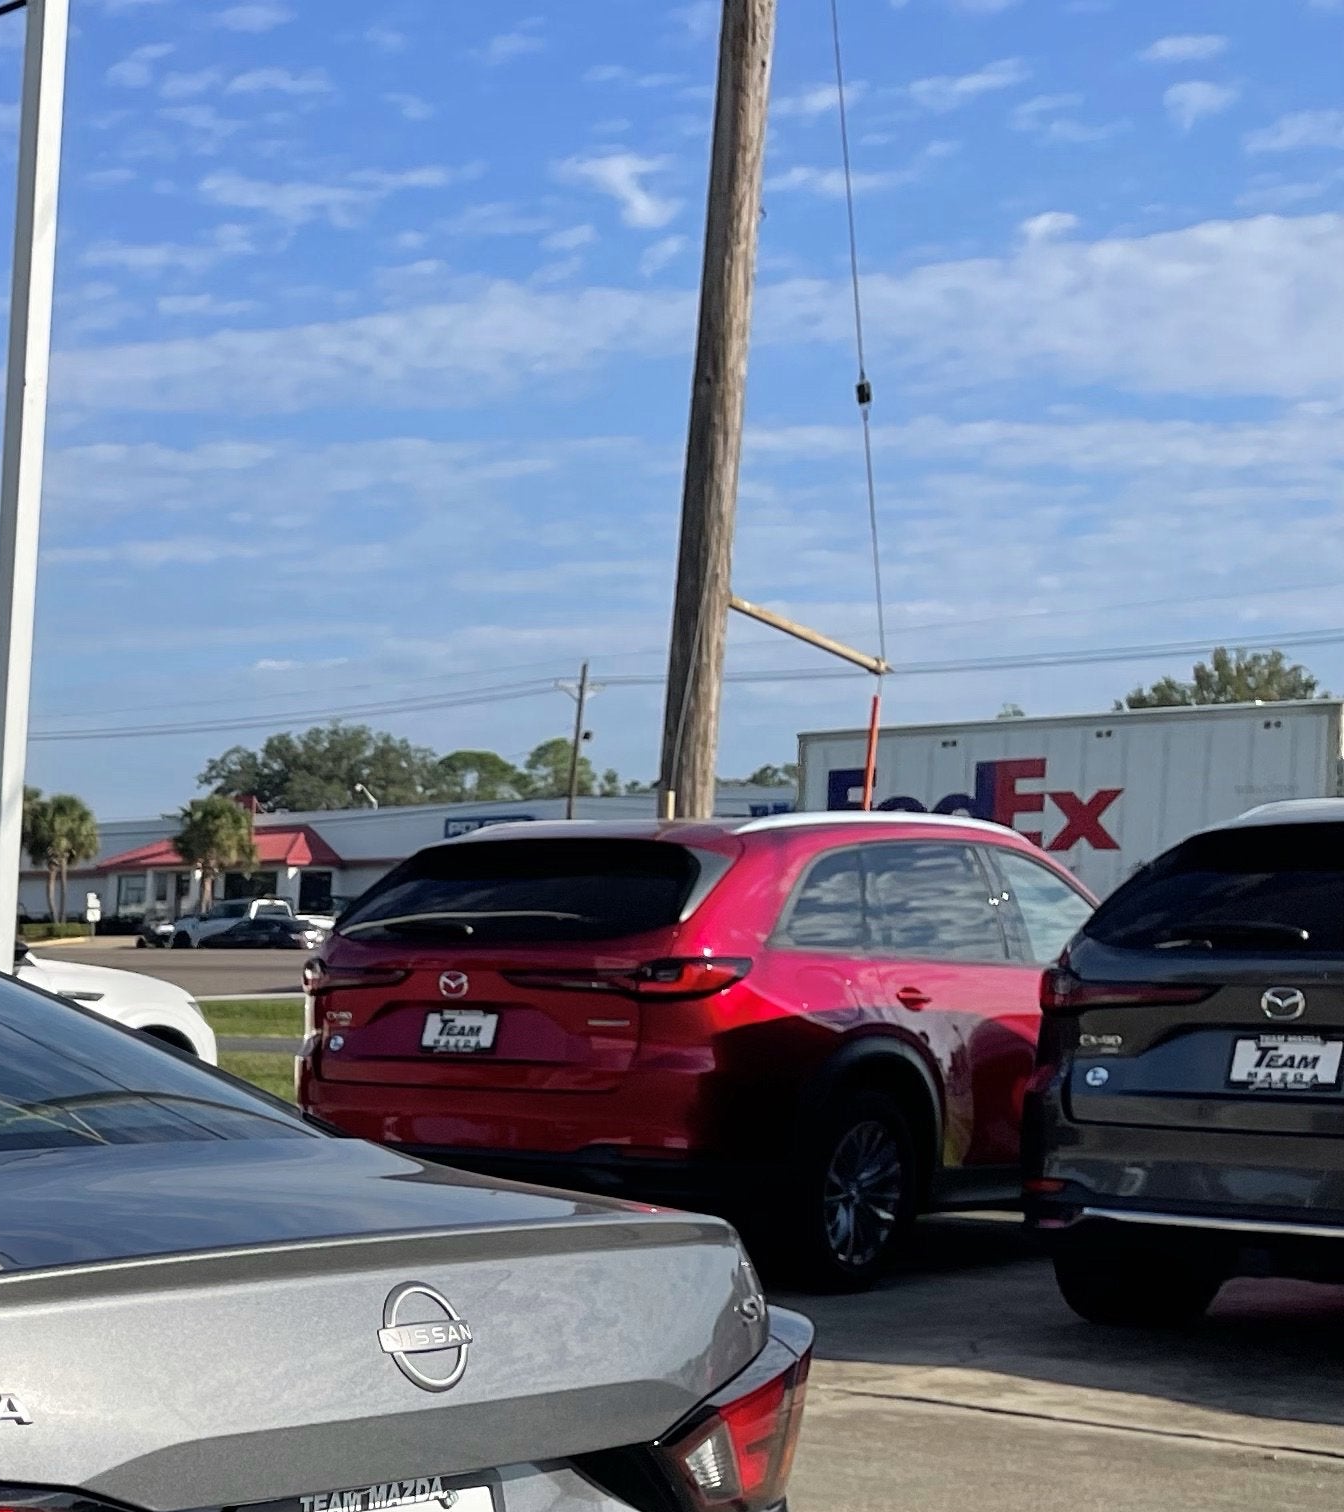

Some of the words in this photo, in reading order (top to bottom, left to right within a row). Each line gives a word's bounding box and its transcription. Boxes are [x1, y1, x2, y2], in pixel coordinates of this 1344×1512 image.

[828, 758, 1124, 851] FdEx
[439, 1018, 482, 1036] TEAM
[1255, 1046, 1321, 1069] TEAM
[384, 1323, 472, 1349] NISSAN
[368, 1476, 445, 1510] MAZDA
